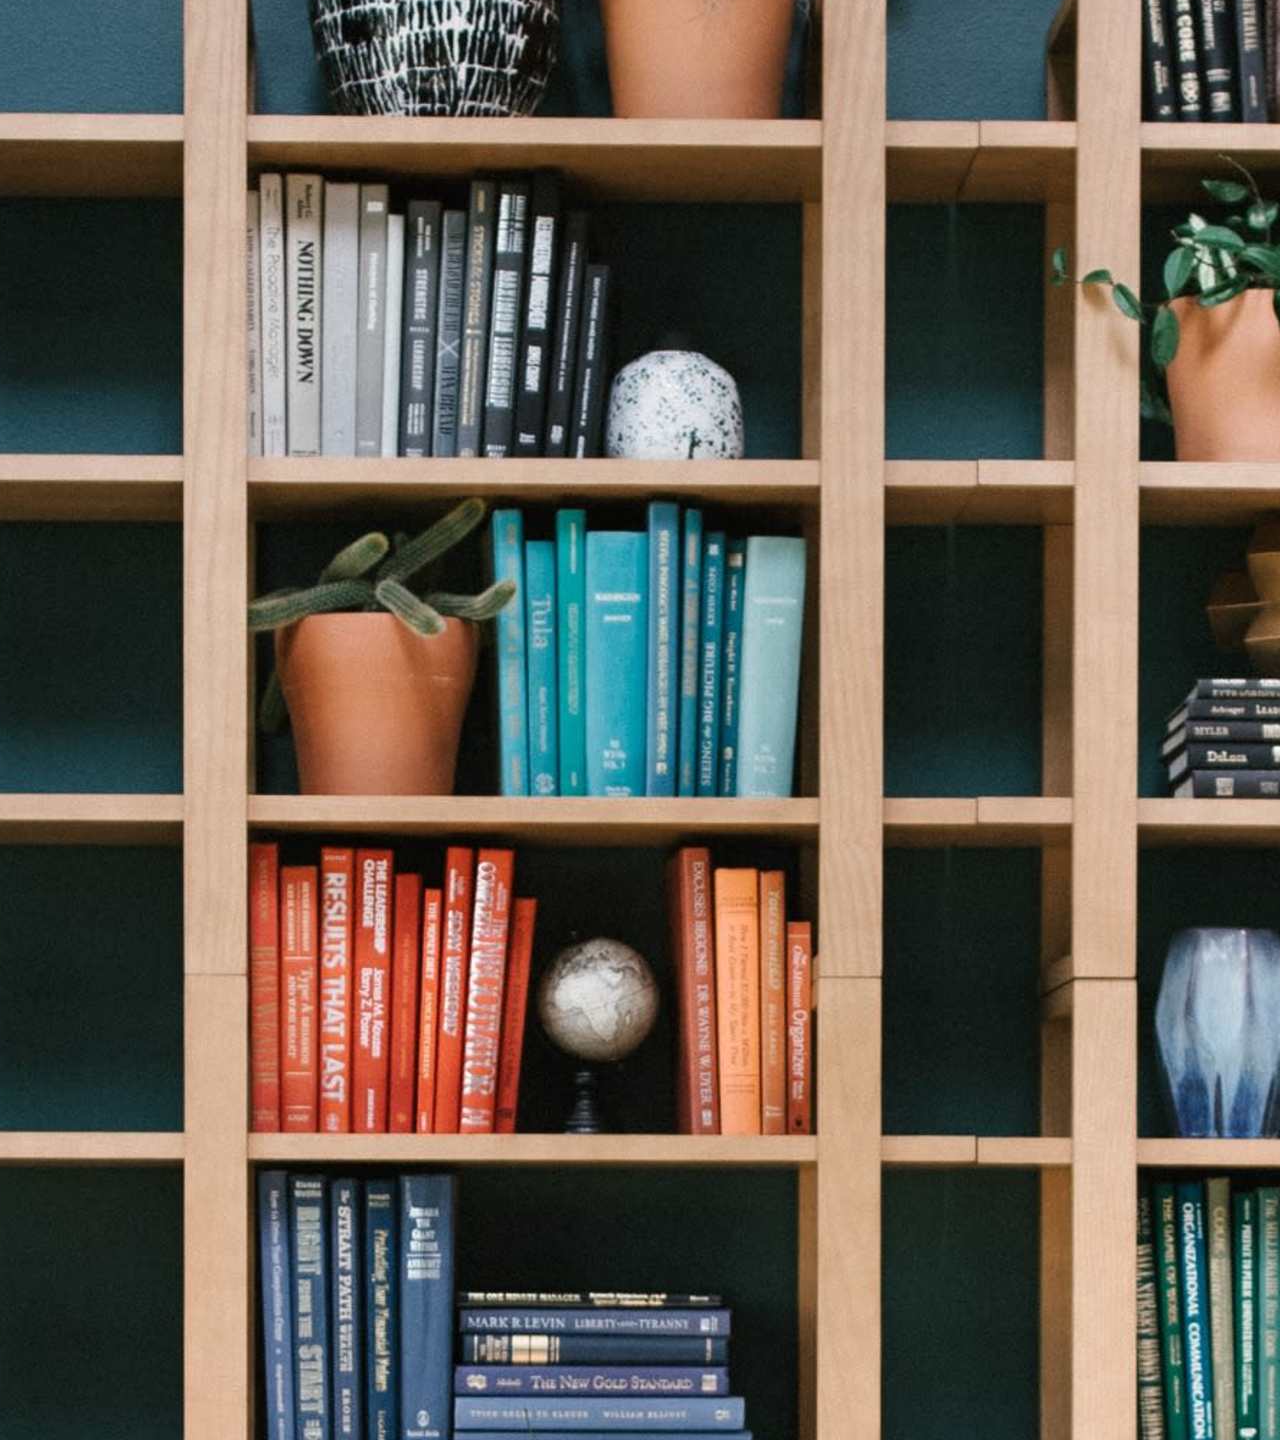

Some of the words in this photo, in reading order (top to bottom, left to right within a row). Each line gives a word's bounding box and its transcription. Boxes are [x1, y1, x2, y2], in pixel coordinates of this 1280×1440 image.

[1178, 15, 1196, 62] CORE
[266, 227, 279, 249] The
[472, 225, 484, 265] STICKS
[265, 254, 279, 313] Proactive
[297, 240, 314, 321] NOTHING
[494, 269, 518, 332] MAXIMUM
[467, 281, 482, 325] STONES
[266, 319, 280, 378] Manager
[297, 328, 313, 384] DOWN
[412, 339, 424, 390] LEADERSHIP
[488, 336, 513, 408] LEADERSHIP
[439, 394, 455, 435] BRAND
[532, 593, 552, 649] Tula
[707, 591, 716, 627] KEVIN
[703, 642, 716, 698] PICTURE
[702, 702, 713, 723] BIG
[1194, 726, 1229, 736] MYLER
[701, 742, 712, 786] SEEING
[375, 859, 387, 883] THE
[693, 861, 706, 917] EXCUSES
[362, 859, 374, 928] CHALLENGE
[474, 861, 496, 939] COMPLETE
[324, 872, 346, 968] RESULTS
[373, 884, 386, 954] LEADERSHIP
[300, 968, 313, 1000] Type
[358, 966, 372, 997] Barry
[373, 967, 385, 1001] James
[301, 1002, 313, 1013] A
[322, 975, 345, 1036] THAT
[361, 999, 371, 1010] Z.
[372, 1002, 383, 1017] M.
[462, 940, 504, 1095] NEGOTIATOR
[697, 1006, 710, 1052] WAYNE
[789, 1009, 808, 1077] Organizer
[322, 1043, 345, 1103] LAST
[699, 1054, 711, 1070] W.
[699, 1071, 712, 1105] DYER
[1162, 1196, 1173, 1222] THE
[297, 1206, 322, 1276] RIGHT
[338, 1205, 352, 1270] STRAIT
[1163, 1225, 1176, 1263] GAME
[1182, 1202, 1199, 1317] ORGANIZATIONAL
[1137, 1243, 1153, 1280] WALL
[1166, 1266, 1176, 1284] OF
[338, 1275, 352, 1321] PATH
[468, 1292, 485, 1302] THE
[486, 1292, 505, 1302] ONE
[506, 1292, 537, 1302] MINUTE
[539, 1292, 581, 1302] MANAGER
[1167, 1289, 1178, 1325] WORK
[468, 1317, 508, 1328] MARK
[509, 1317, 523, 1328] R.
[524, 1317, 566, 1329] LEVIN
[574, 1318, 617, 1329] LIBERTY
[640, 1318, 690, 1330] TYRANNY
[298, 1344, 323, 1414] START
[532, 1376, 556, 1390] THE
[559, 1376, 591, 1390] NEW
[592, 1376, 628, 1390] GOLD
[630, 1376, 693, 1390] STANDARD
[1188, 1322, 1206, 1440] COMMUNICATION
[342, 1388, 352, 1433] KROHN
[603, 1410, 644, 1419] WILLIAM
